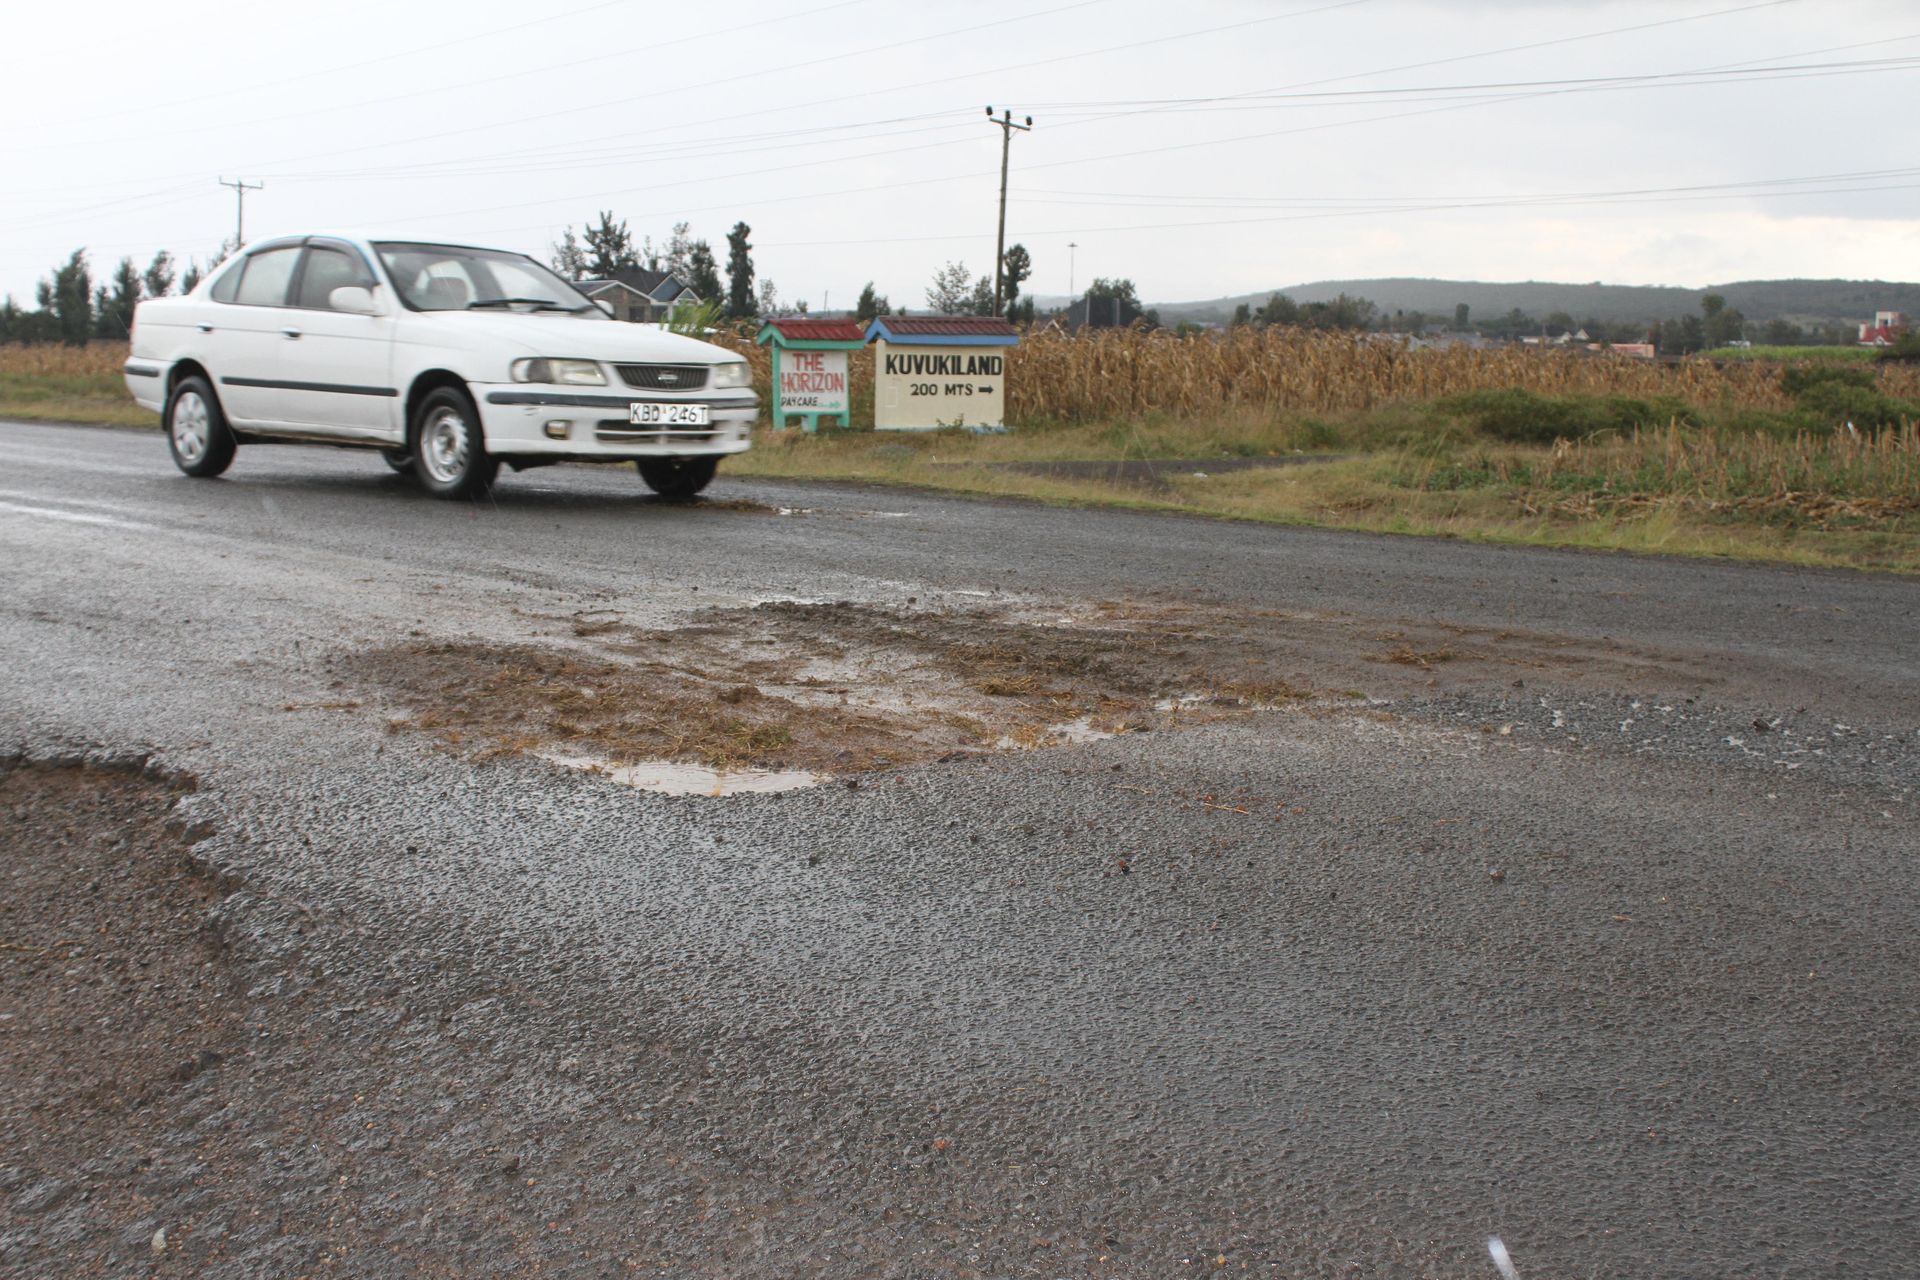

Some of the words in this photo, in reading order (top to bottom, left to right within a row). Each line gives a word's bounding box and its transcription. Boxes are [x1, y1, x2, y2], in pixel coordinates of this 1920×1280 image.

[792, 352, 825, 371] THE
[885, 354, 1003, 376] KUVUKILAND
[781, 372, 844, 393] HORIZON
[910, 383, 938, 396] 200
[944, 383, 974, 396] MTS
[631, 403, 660, 422] KBD
[669, 405, 707, 423] 246T
